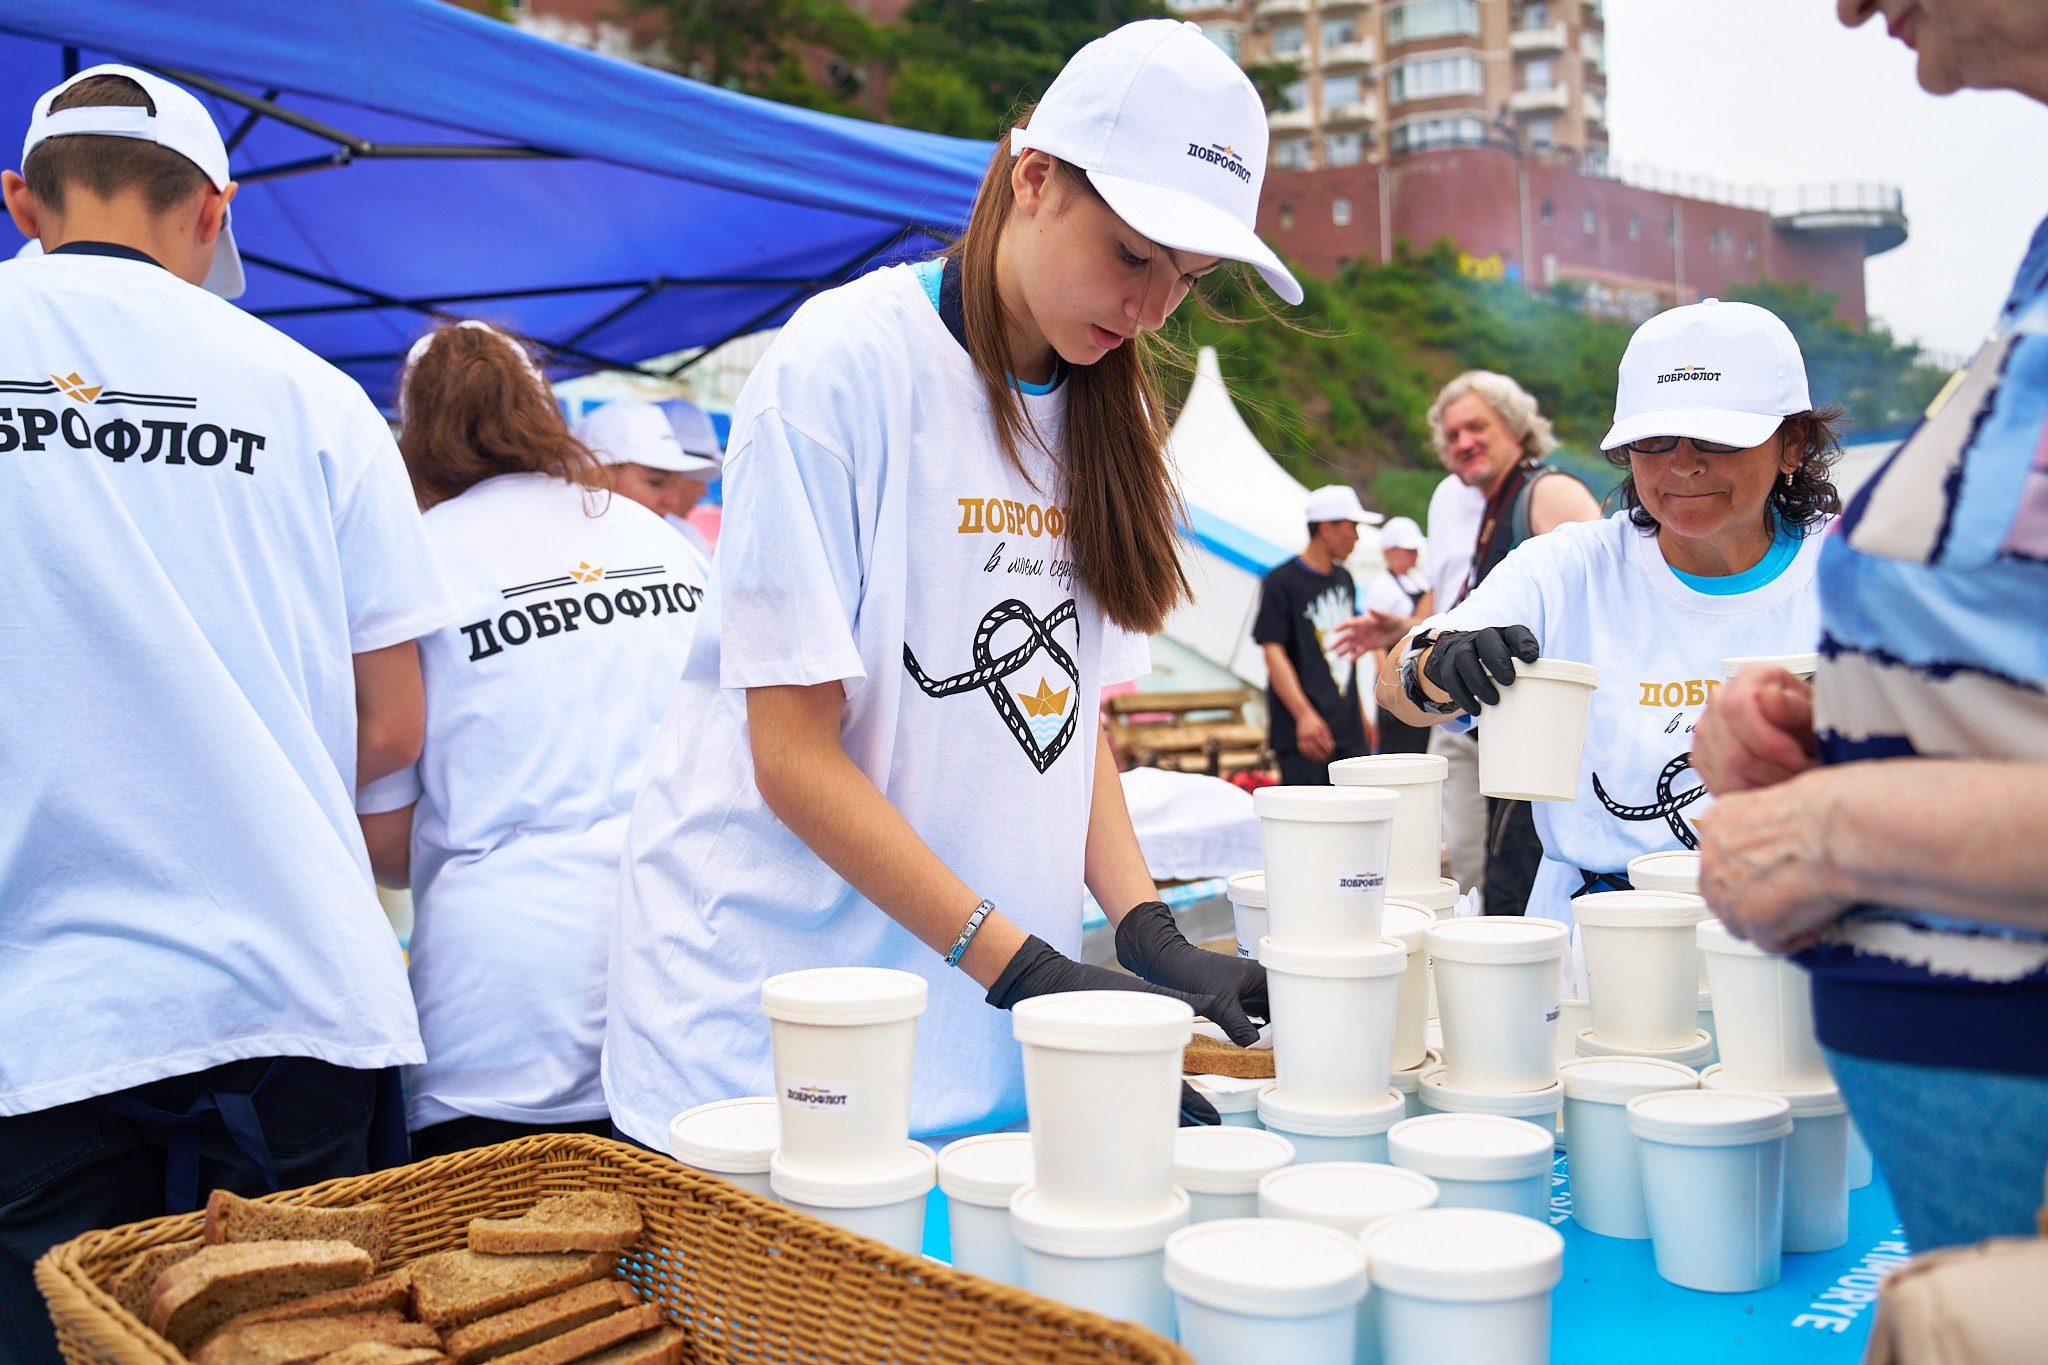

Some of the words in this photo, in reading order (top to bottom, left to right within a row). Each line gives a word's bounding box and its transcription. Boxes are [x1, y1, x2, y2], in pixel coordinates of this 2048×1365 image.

[1187, 143, 1251, 184] ДОБРОФЛОТ
[1657, 372, 1721, 384] ДОБРОФЛОТ
[787, 1089, 848, 1105] ДОБРОФЛОТ
